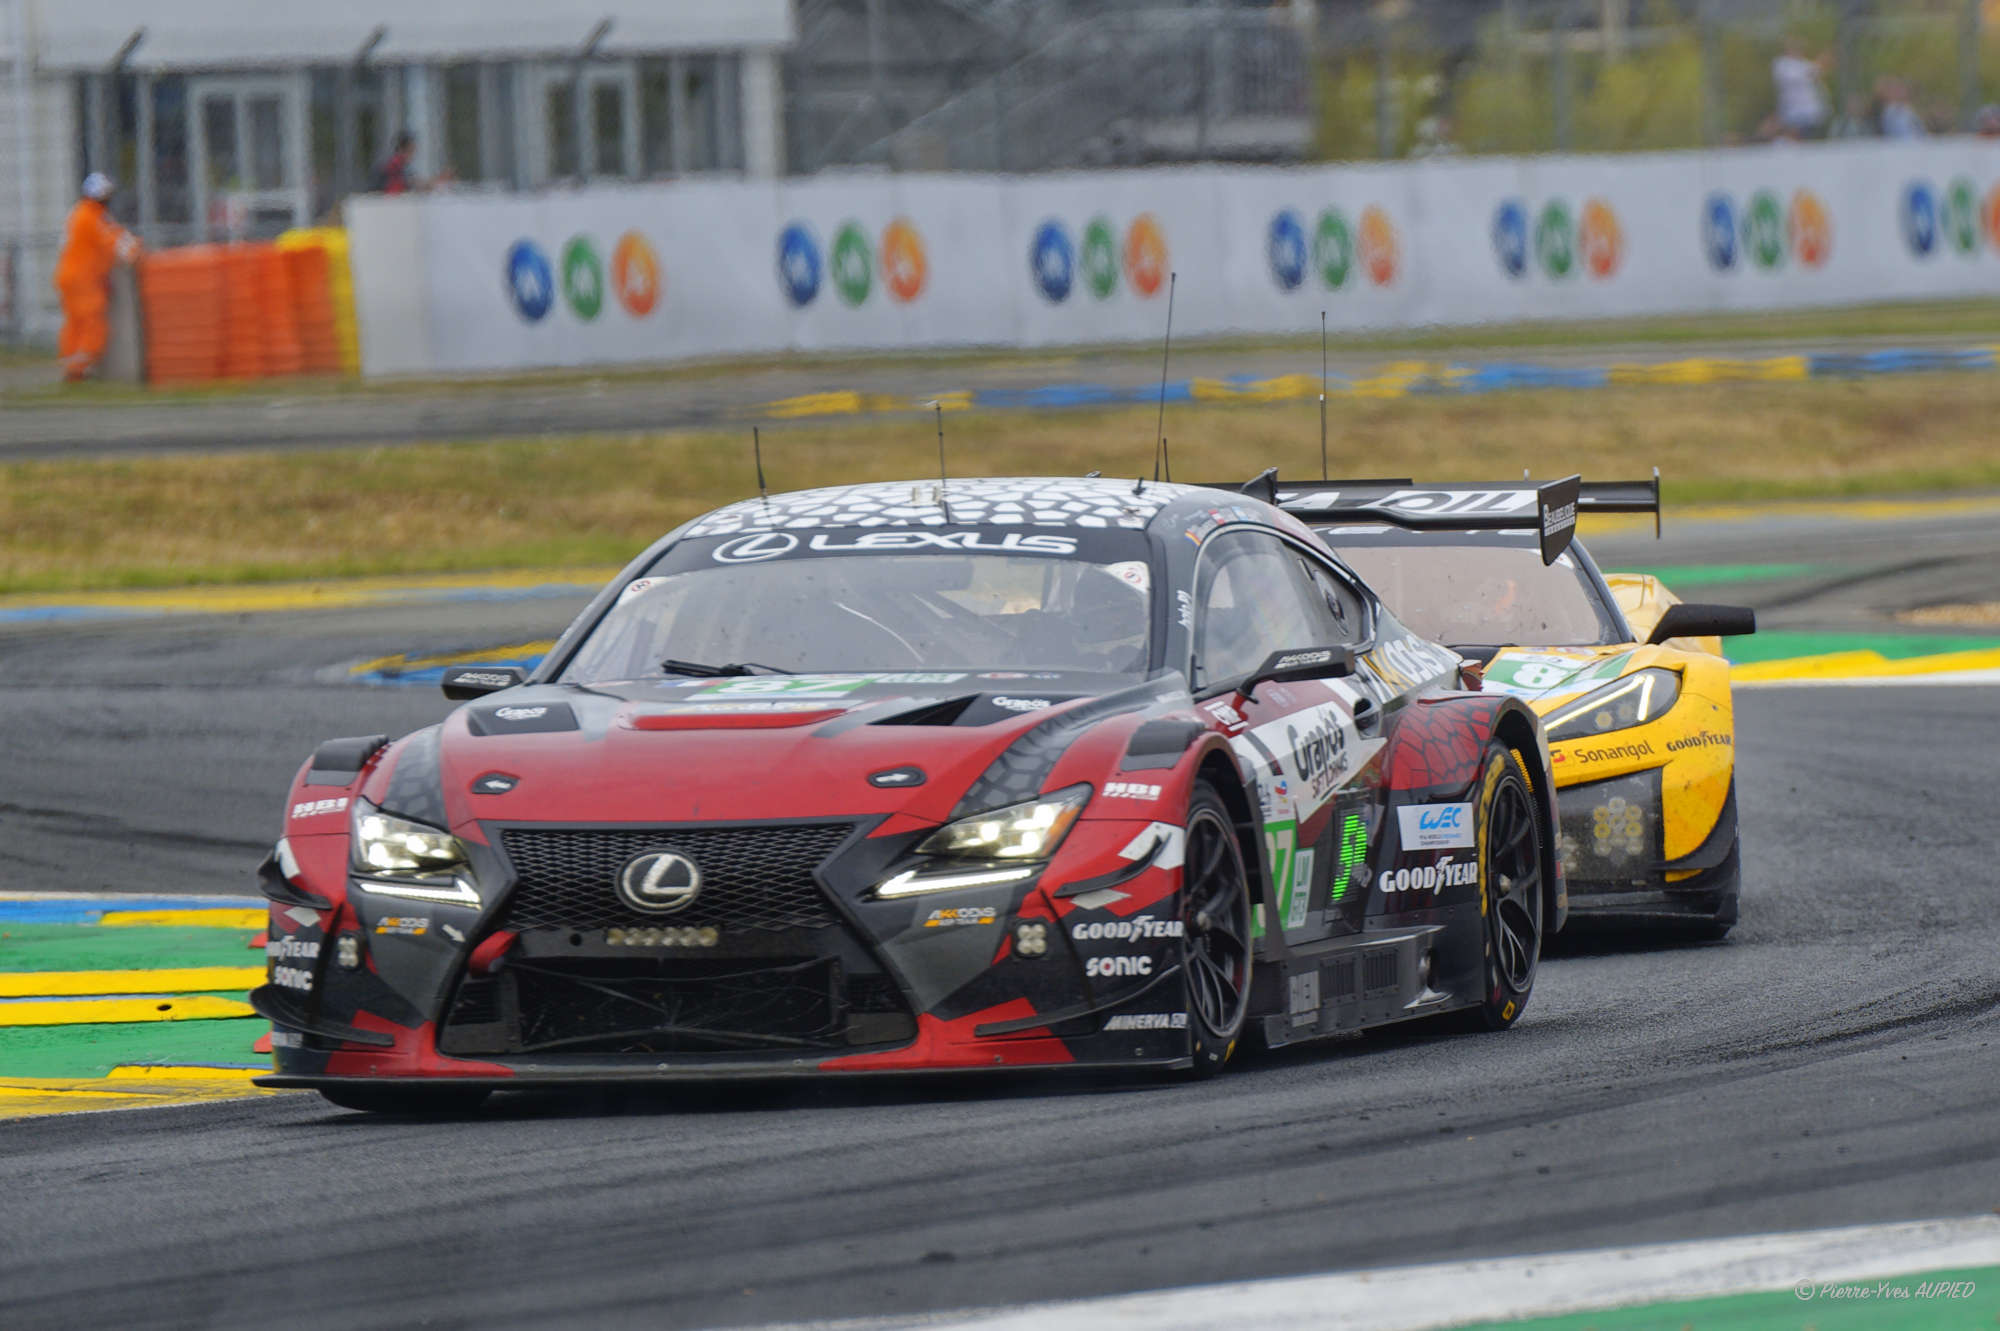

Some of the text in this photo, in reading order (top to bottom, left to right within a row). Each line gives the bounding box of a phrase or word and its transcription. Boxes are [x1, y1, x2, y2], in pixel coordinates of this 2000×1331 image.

[809, 531, 1079, 555] LEXUS
[1574, 740, 1655, 764] Sonangol
[1666, 731, 1732, 753] GOODYEAR
[1418, 806, 1462, 830] WEC
[1378, 856, 1478, 896] GOODYEAR
[1072, 915, 1185, 943] GOODYEAR
[1085, 956, 1152, 977] SONIC
